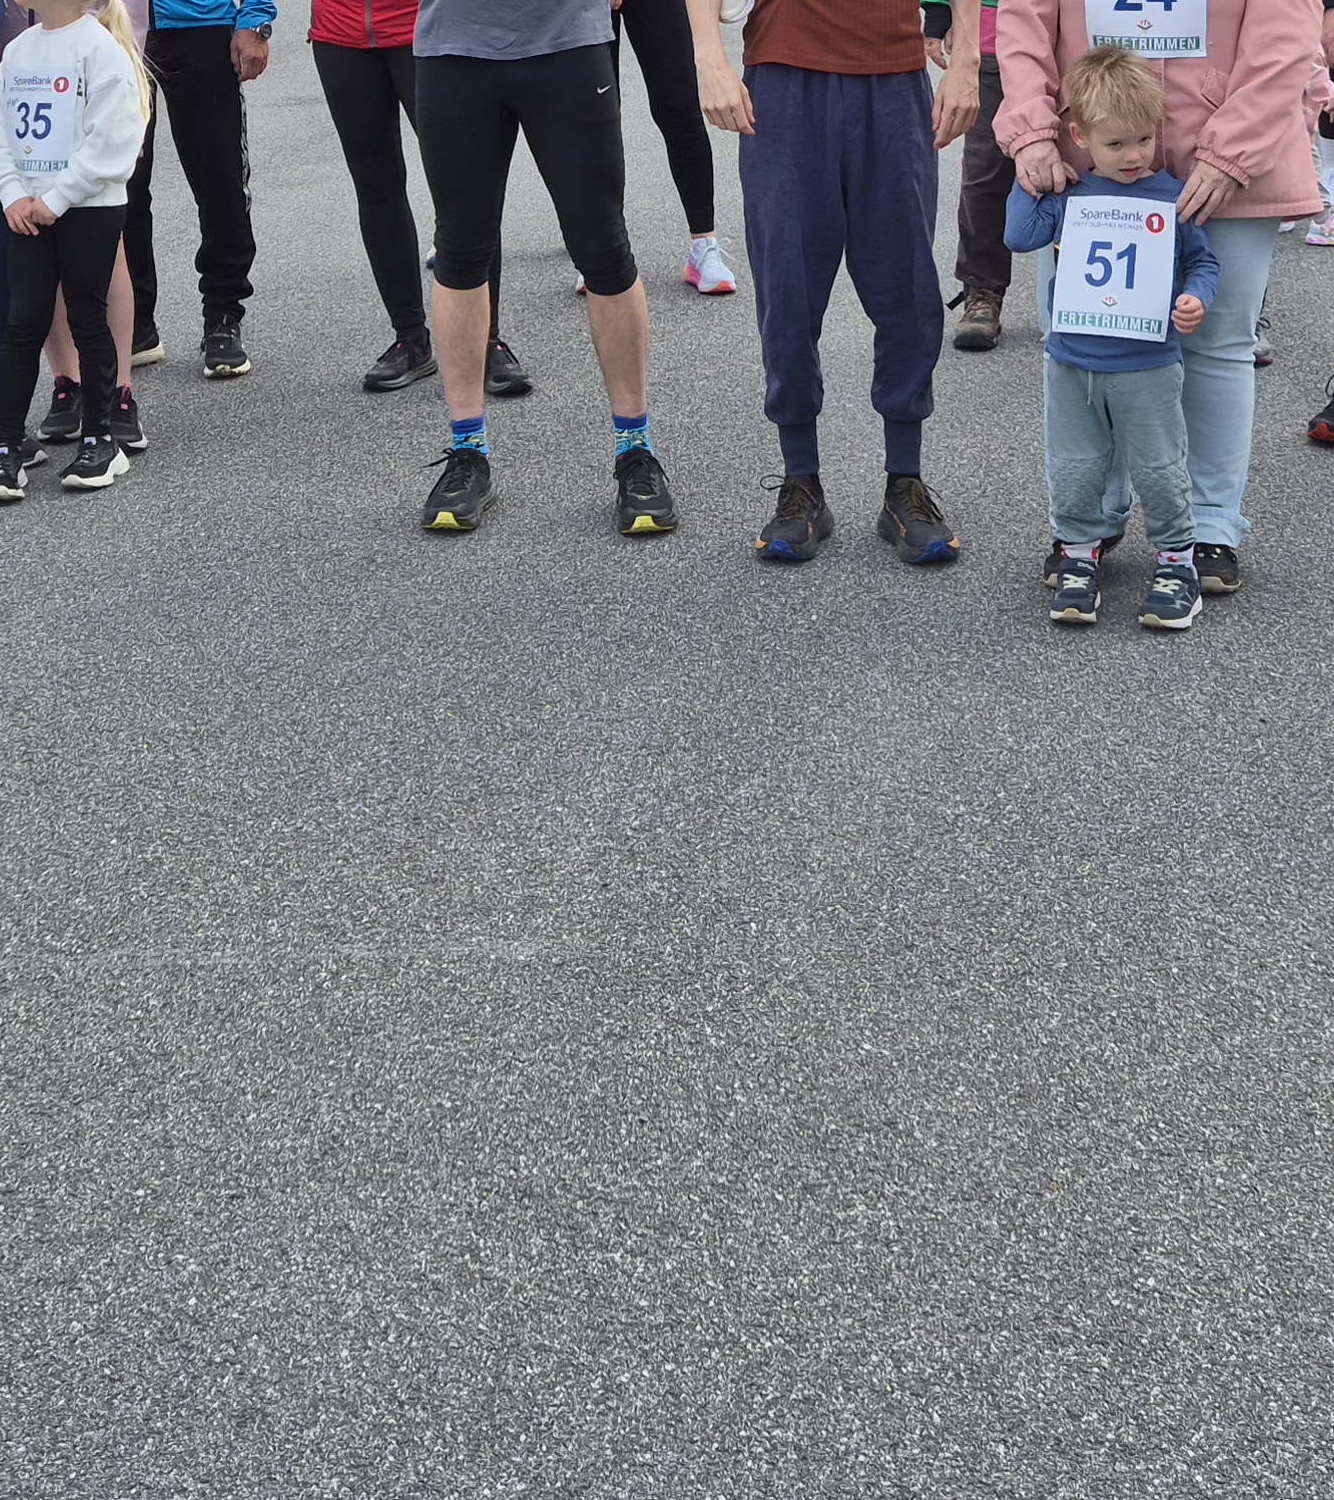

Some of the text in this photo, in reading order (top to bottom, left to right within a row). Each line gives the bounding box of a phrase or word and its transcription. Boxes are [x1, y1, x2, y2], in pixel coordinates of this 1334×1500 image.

[1097, 35, 1196, 50] ERTETRIMMEN
[14, 76, 52, 85] SpareBank
[15, 102, 52, 140] 35
[1080, 208, 1143, 223] SpareBank
[1084, 241, 1137, 290] 51
[1061, 312, 1158, 332] ERTETRIMMEN
